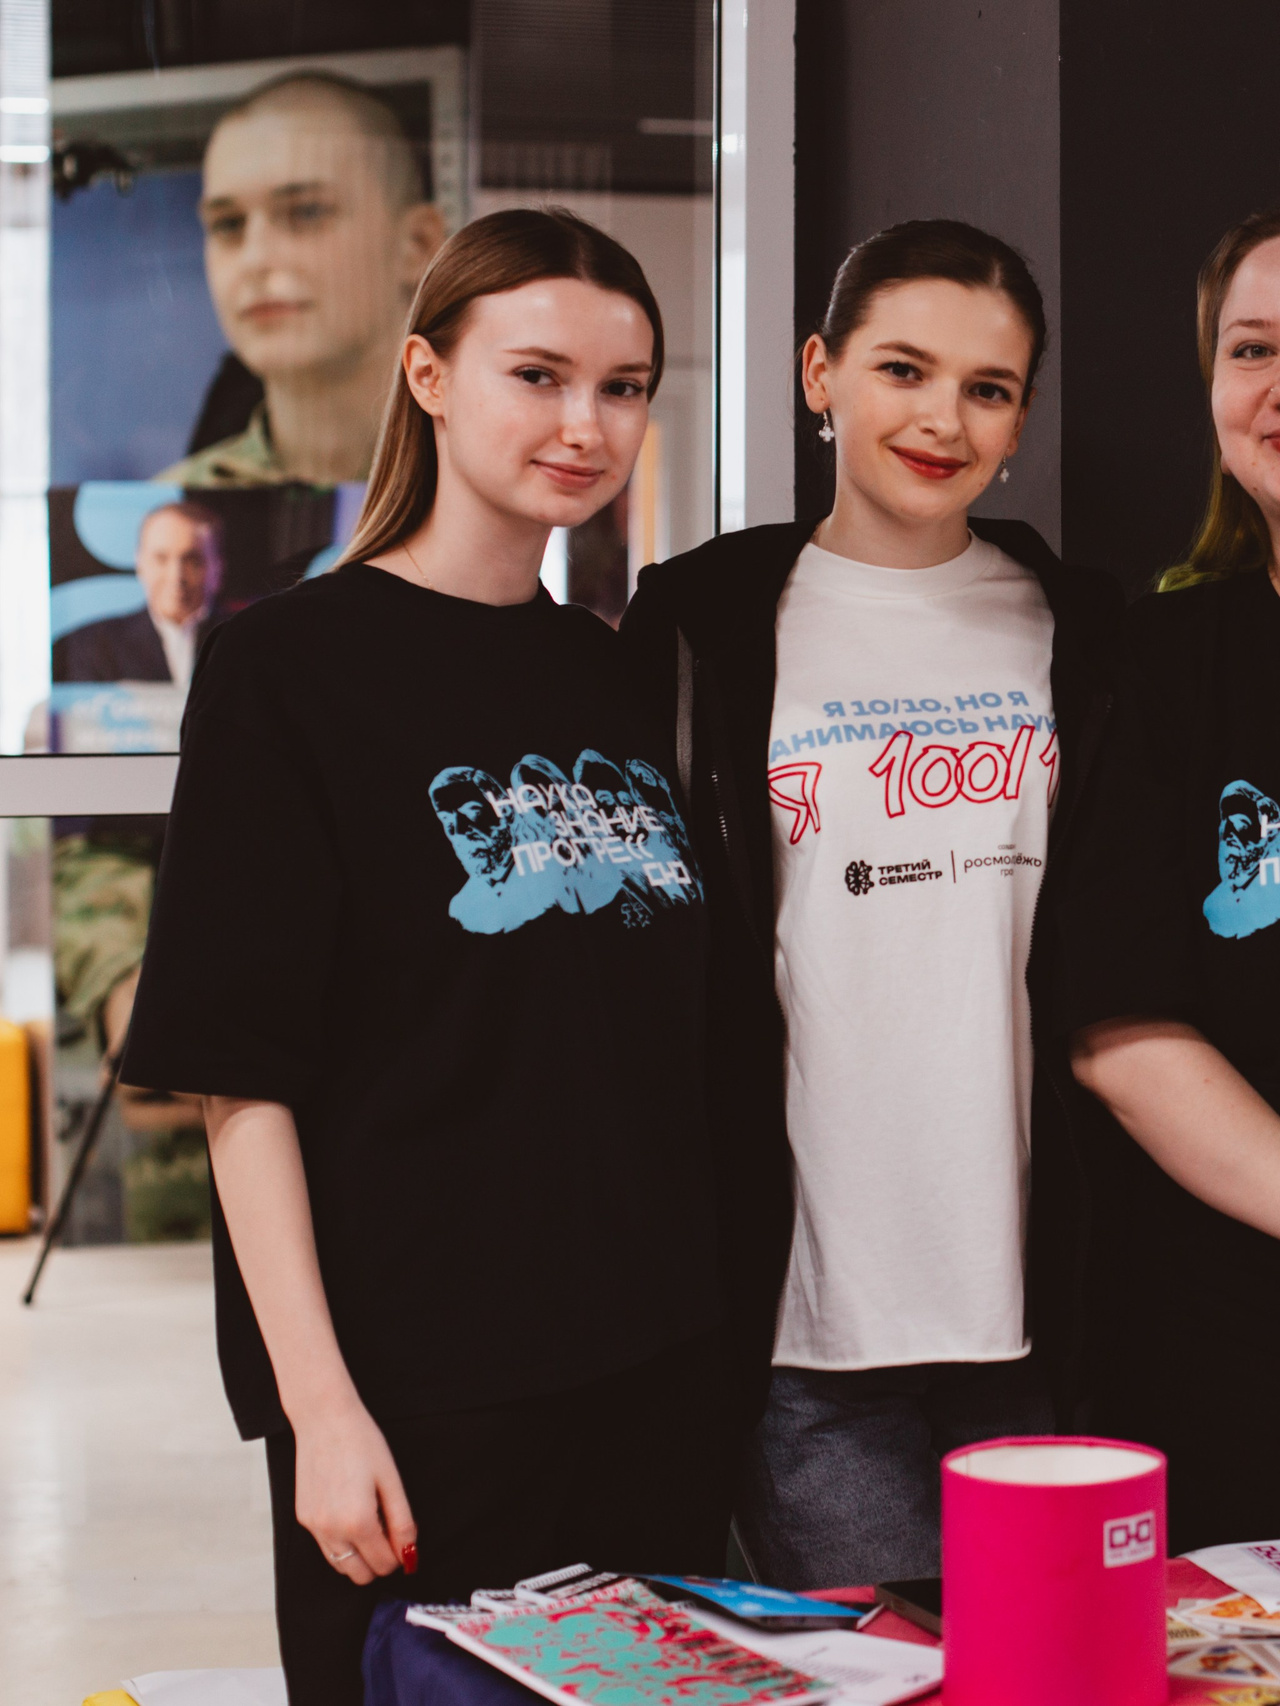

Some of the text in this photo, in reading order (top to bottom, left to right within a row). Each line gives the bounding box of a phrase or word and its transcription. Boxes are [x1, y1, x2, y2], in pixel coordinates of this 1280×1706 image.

[822, 701, 846, 718] Я
[954, 692, 1003, 712] НО
[1007, 691, 1029, 707] Я
[768, 718, 980, 764] АНИМАЮСЬ
[486, 783, 598, 818] НАУКА
[550, 806, 665, 838] ЗНАНИЕ
[511, 833, 653, 877] ПРОГРЕСС
[878, 859, 931, 876] ТРЕТИЙ
[879, 870, 943, 886] СЕМЕСТР
